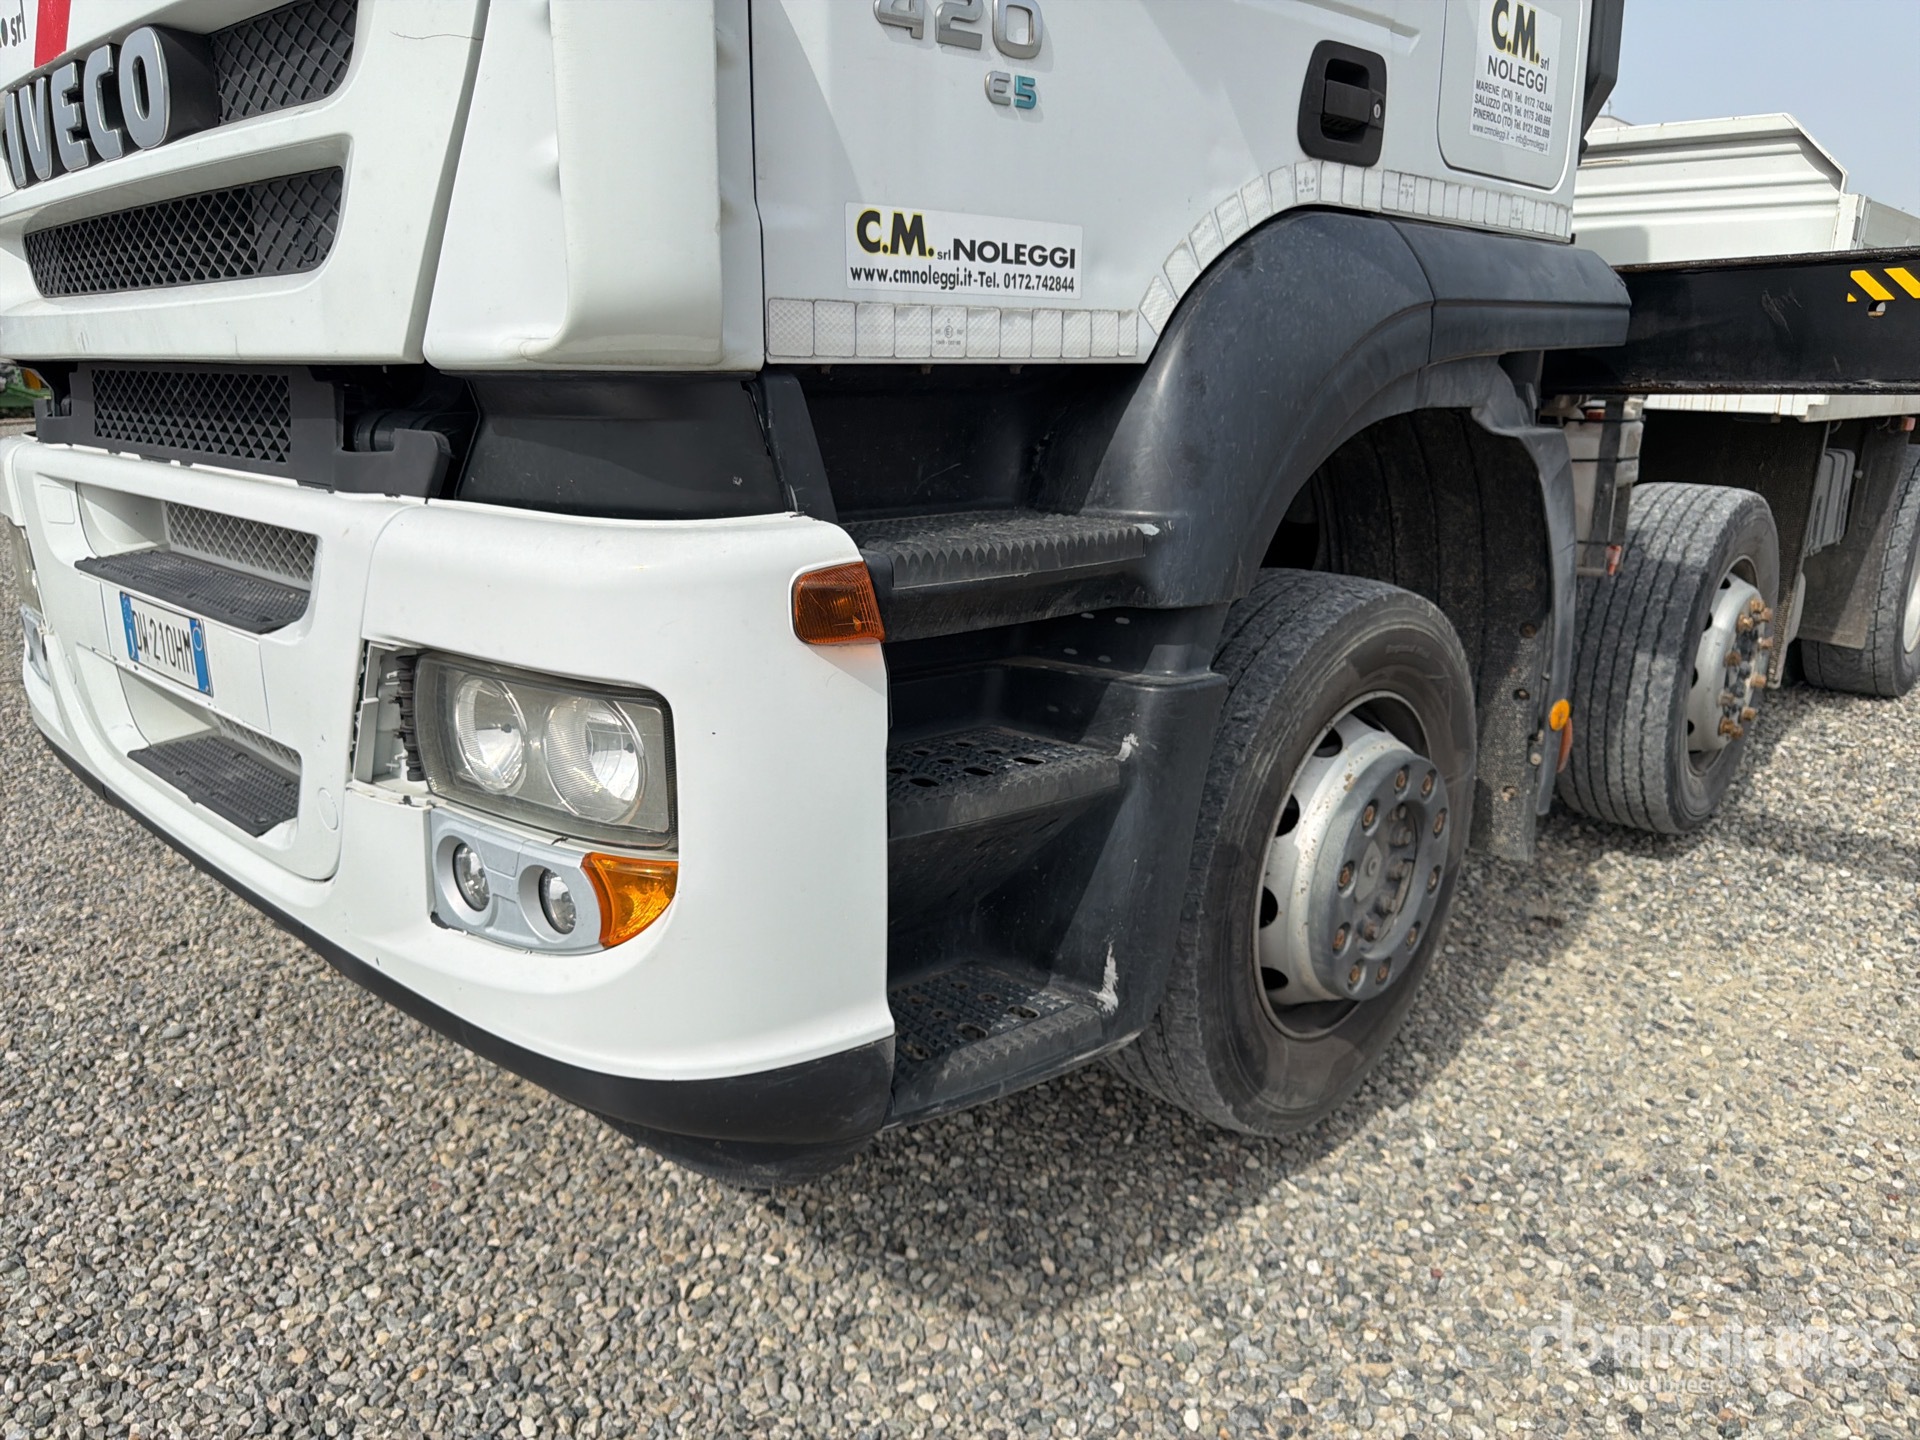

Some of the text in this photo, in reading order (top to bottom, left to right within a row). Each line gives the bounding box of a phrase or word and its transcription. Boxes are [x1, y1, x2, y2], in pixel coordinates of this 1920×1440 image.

[873, 0, 1043, 59] 420
[1491, 0, 1550, 71] C.M. srl
[1475, 79, 1501, 96] MARENE
[1501, 88, 1513, 102] (CN)
[1524, 95, 1536, 108] 0172
[1487, 54, 1548, 95] NOLEGGI
[3, 25, 170, 190] IVECO
[1473, 107, 1501, 125] PINEROLO
[1501, 115, 1513, 130] (TO)
[1474, 93, 1501, 110] SALUZZO
[1501, 101, 1513, 116] (CN)
[856, 208, 1076, 270] C.M. srl NOLEGGI
[1003, 272, 1075, 293] 0172.742844
